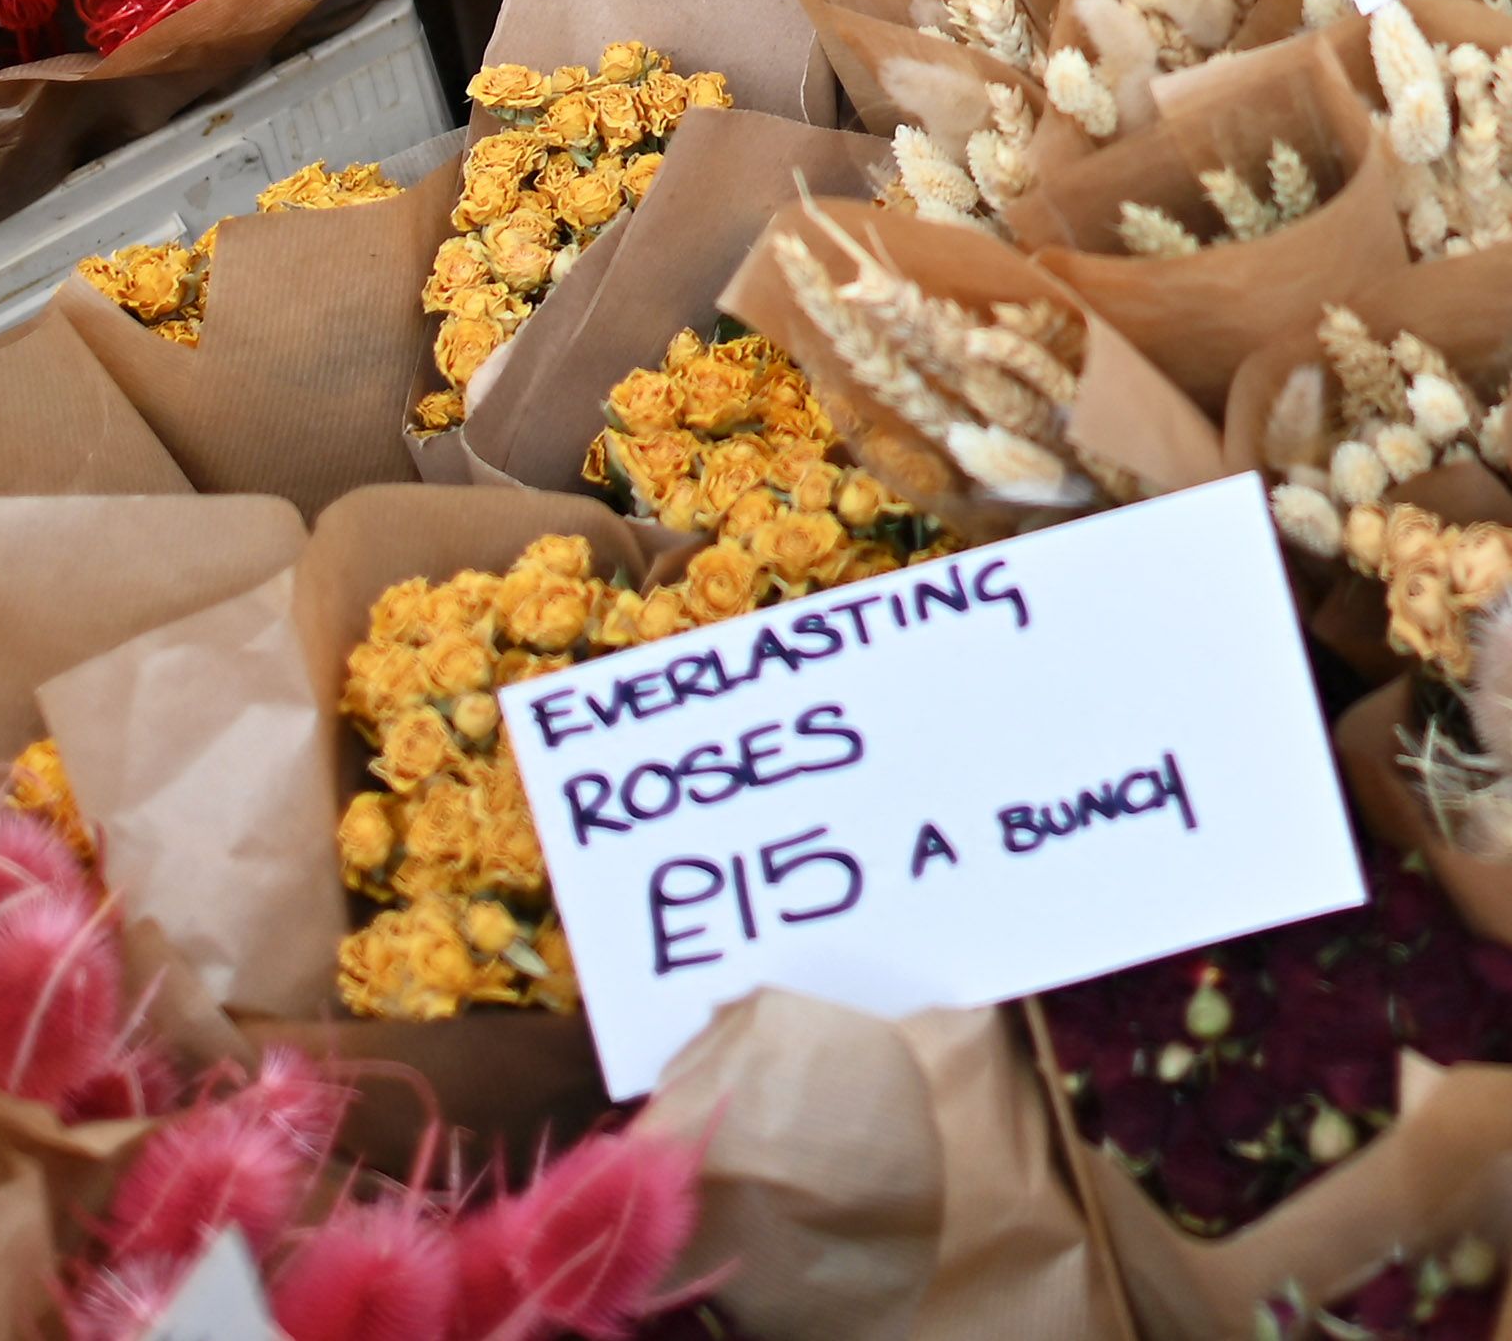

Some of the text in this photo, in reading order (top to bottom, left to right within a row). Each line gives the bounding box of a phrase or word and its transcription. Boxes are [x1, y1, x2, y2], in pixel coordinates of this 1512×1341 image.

[529, 559, 1031, 748] EVERLASTING
[563, 701, 865, 846] ROSES
[648, 748, 1198, 976] £15 A BUNCH
